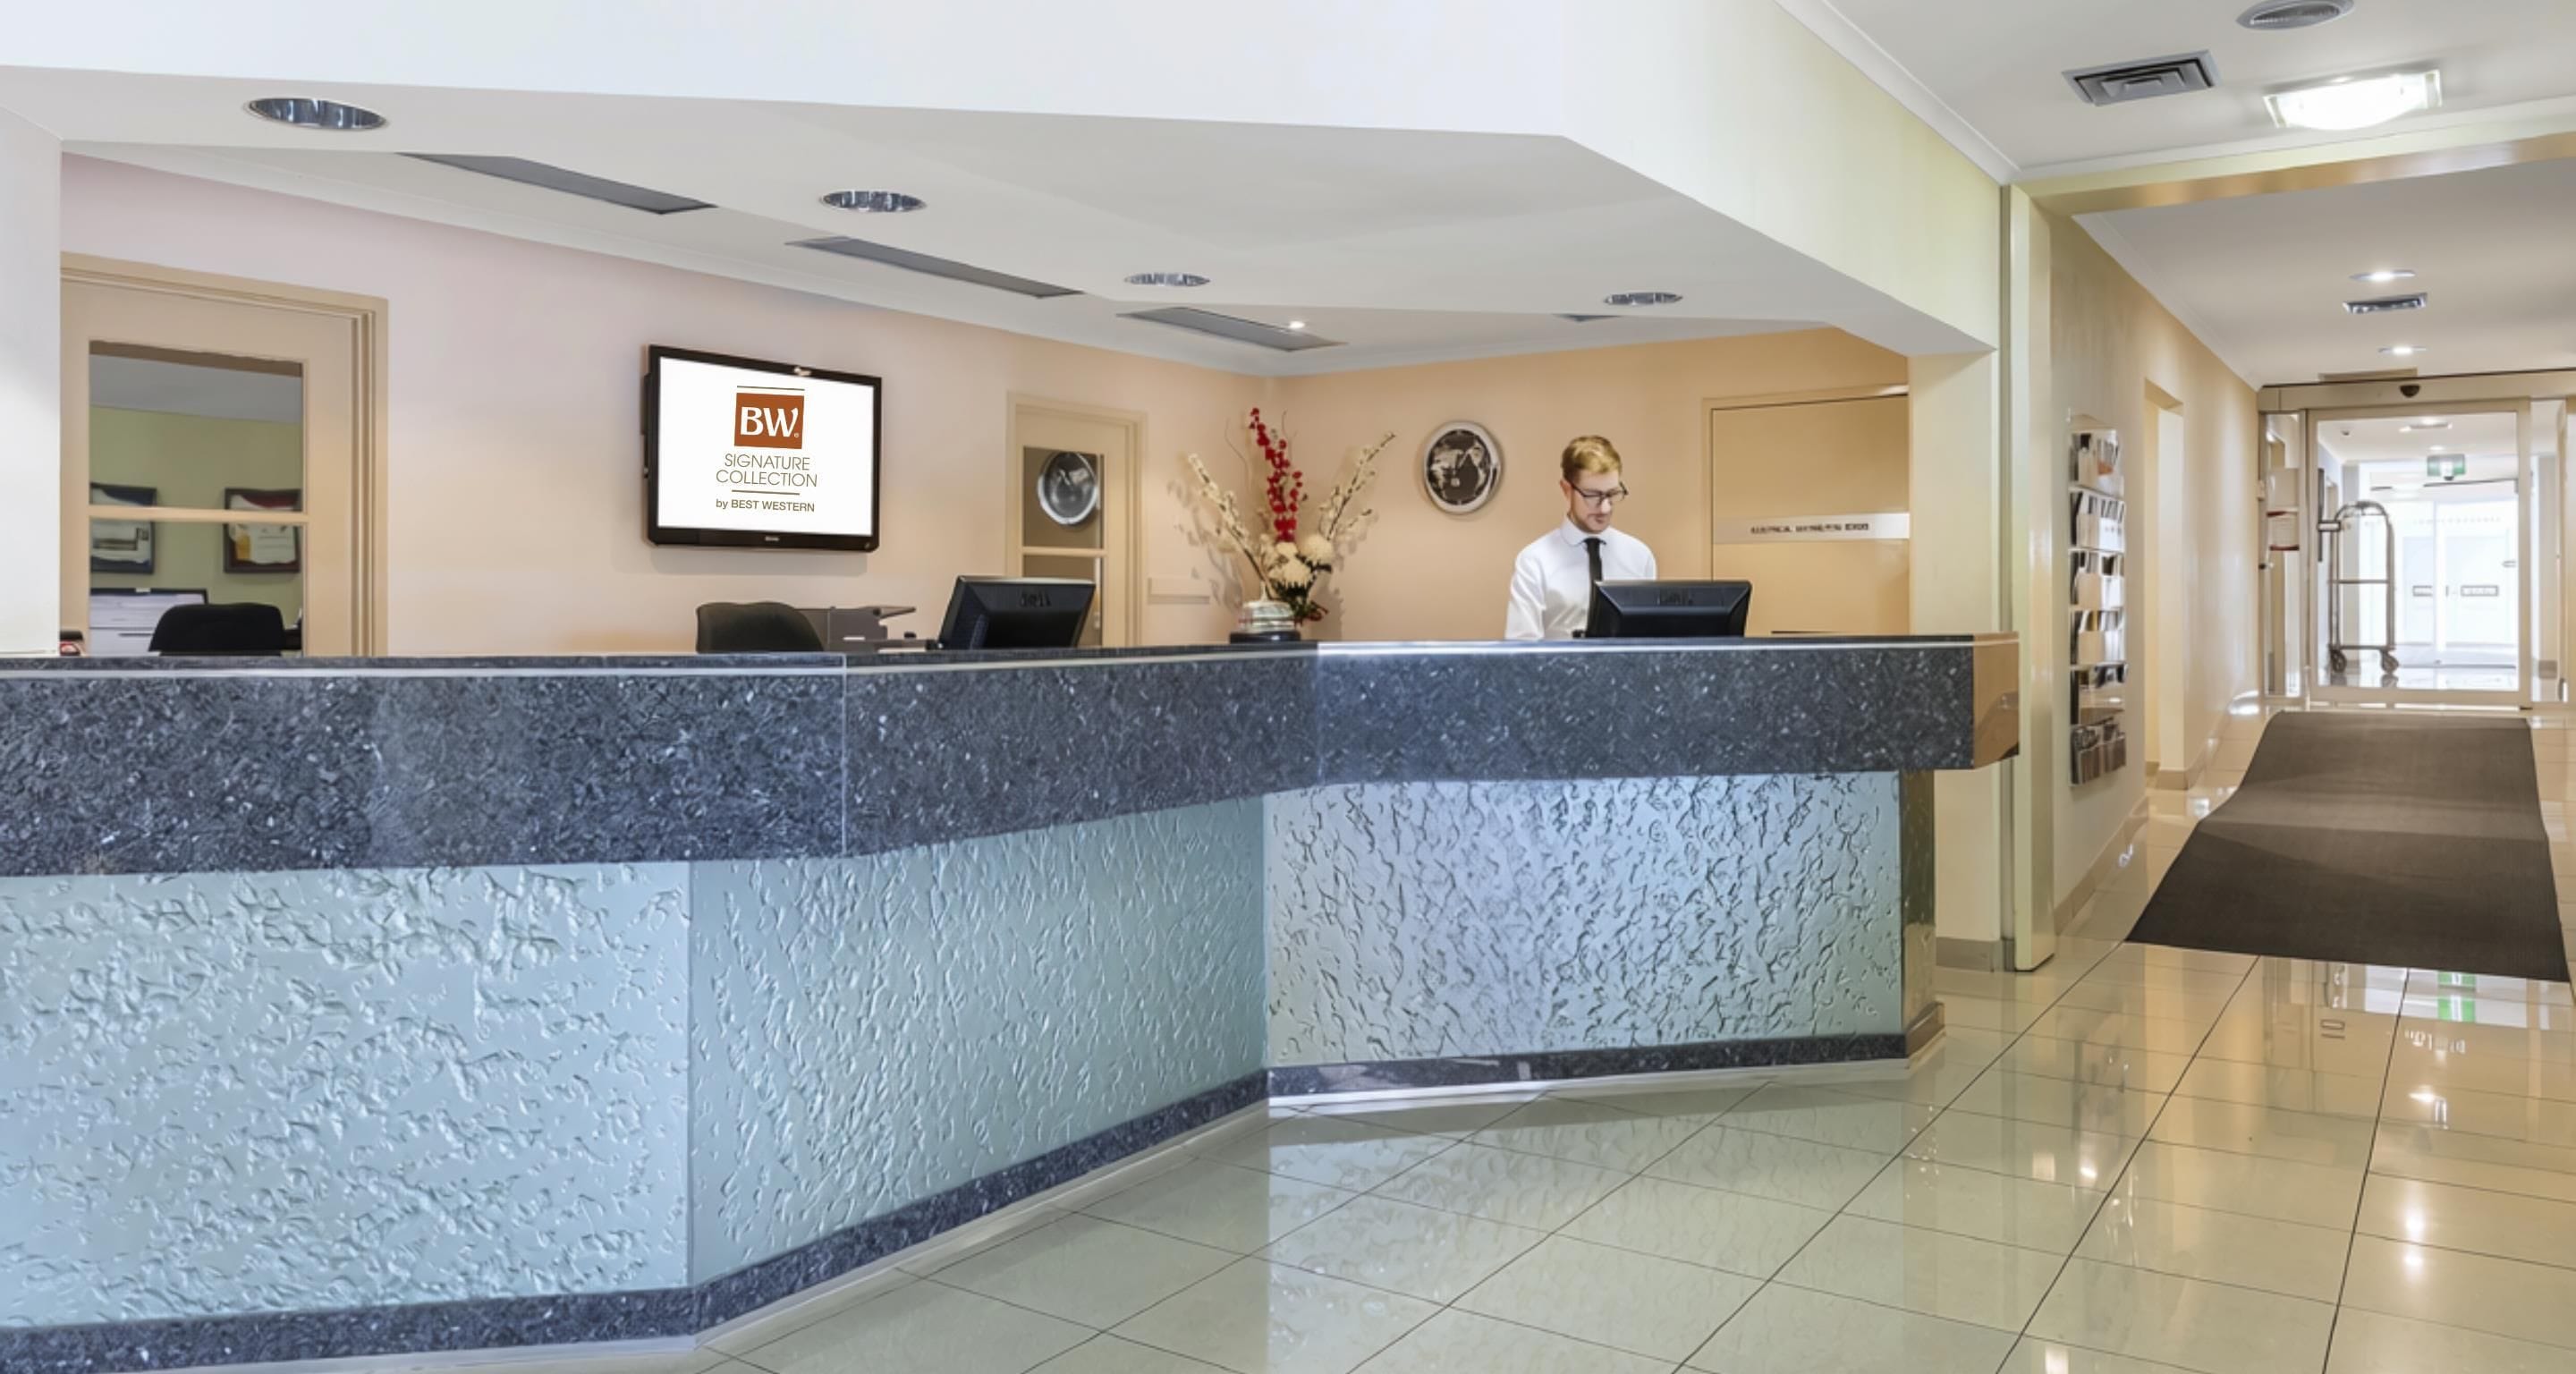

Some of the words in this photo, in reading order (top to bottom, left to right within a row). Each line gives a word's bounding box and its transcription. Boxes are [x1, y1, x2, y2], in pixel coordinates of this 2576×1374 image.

[724, 453, 810, 471] SIGNATURE
[716, 470, 818, 488] COLLECTION
[716, 498, 729, 510] by
[731, 499, 760, 510] BEST
[761, 500, 815, 513] WESTERN
